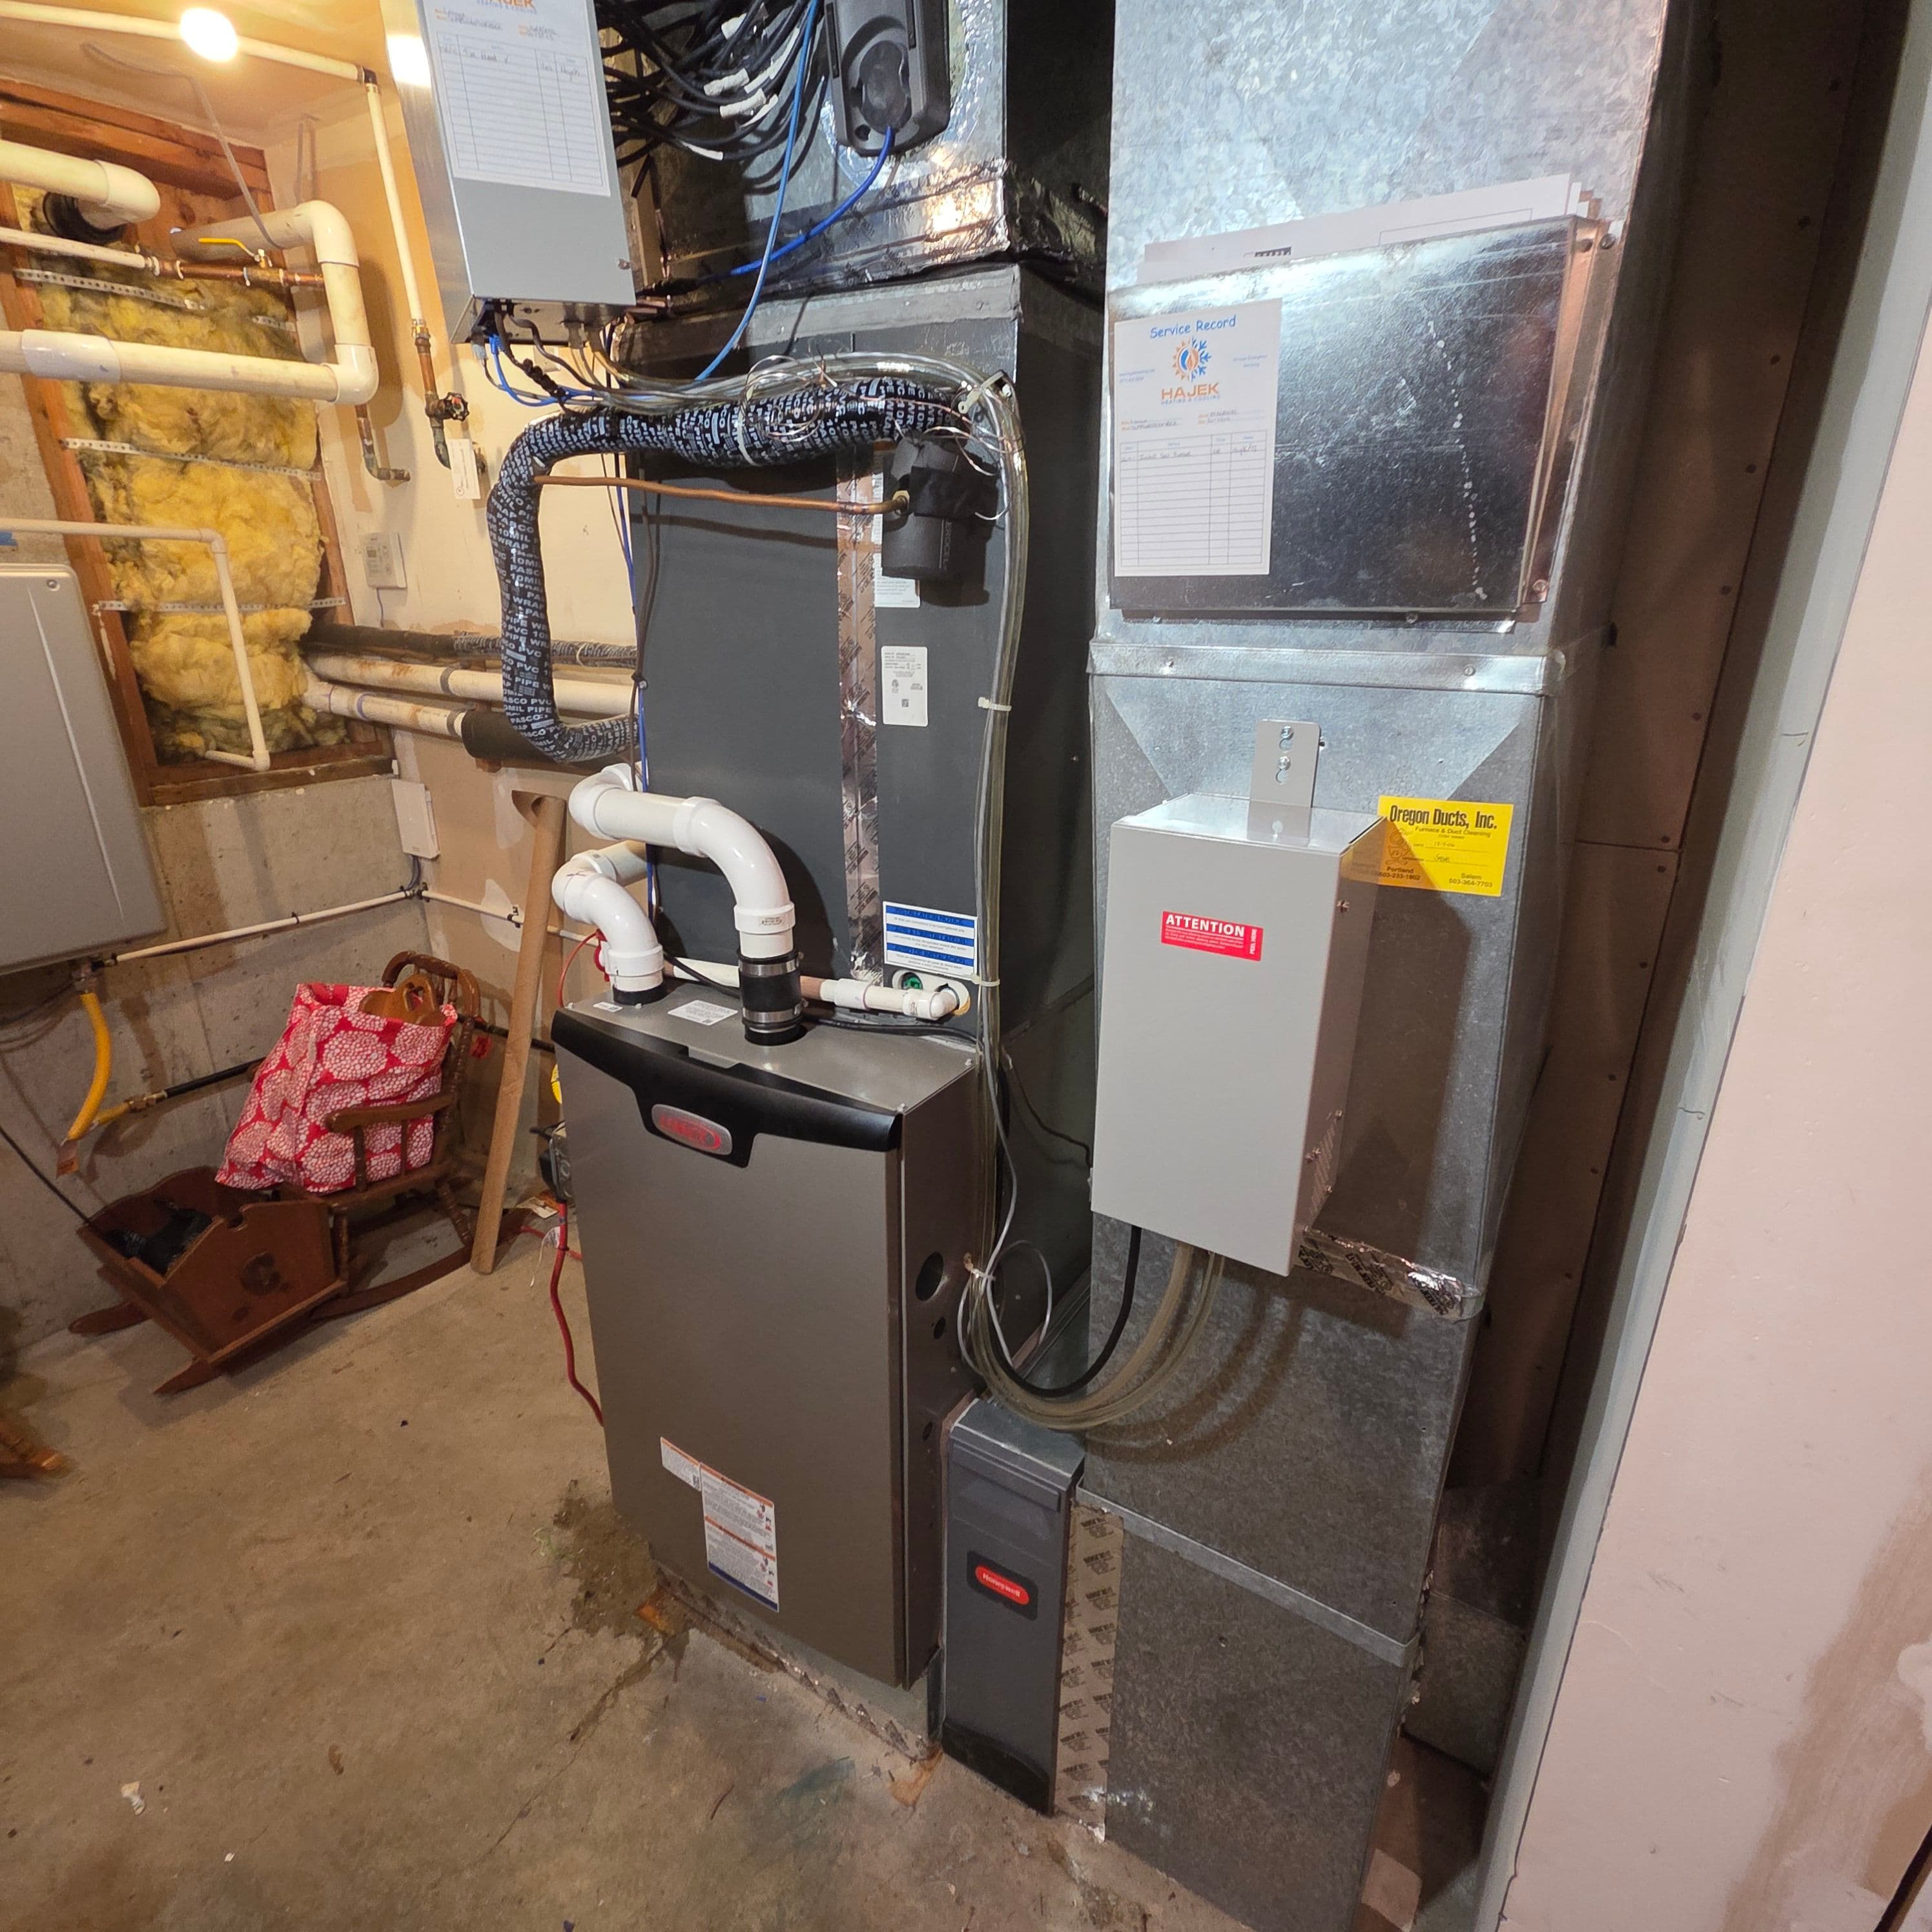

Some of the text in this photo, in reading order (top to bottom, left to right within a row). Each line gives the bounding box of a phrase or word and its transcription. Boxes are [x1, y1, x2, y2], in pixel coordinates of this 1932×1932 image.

[1150, 314, 1236, 338] Service Record
[1161, 382, 1219, 400] HAJEK
[510, 564, 542, 576] PASC
[508, 624, 528, 635] PVC
[517, 661, 539, 673] PVC
[515, 676, 540, 688] PIPE
[1390, 805, 1497, 829] Oregon Ducts, Inc.
[1463, 829, 1491, 838] Cleaning
[1166, 914, 1245, 937] ATTENTION
